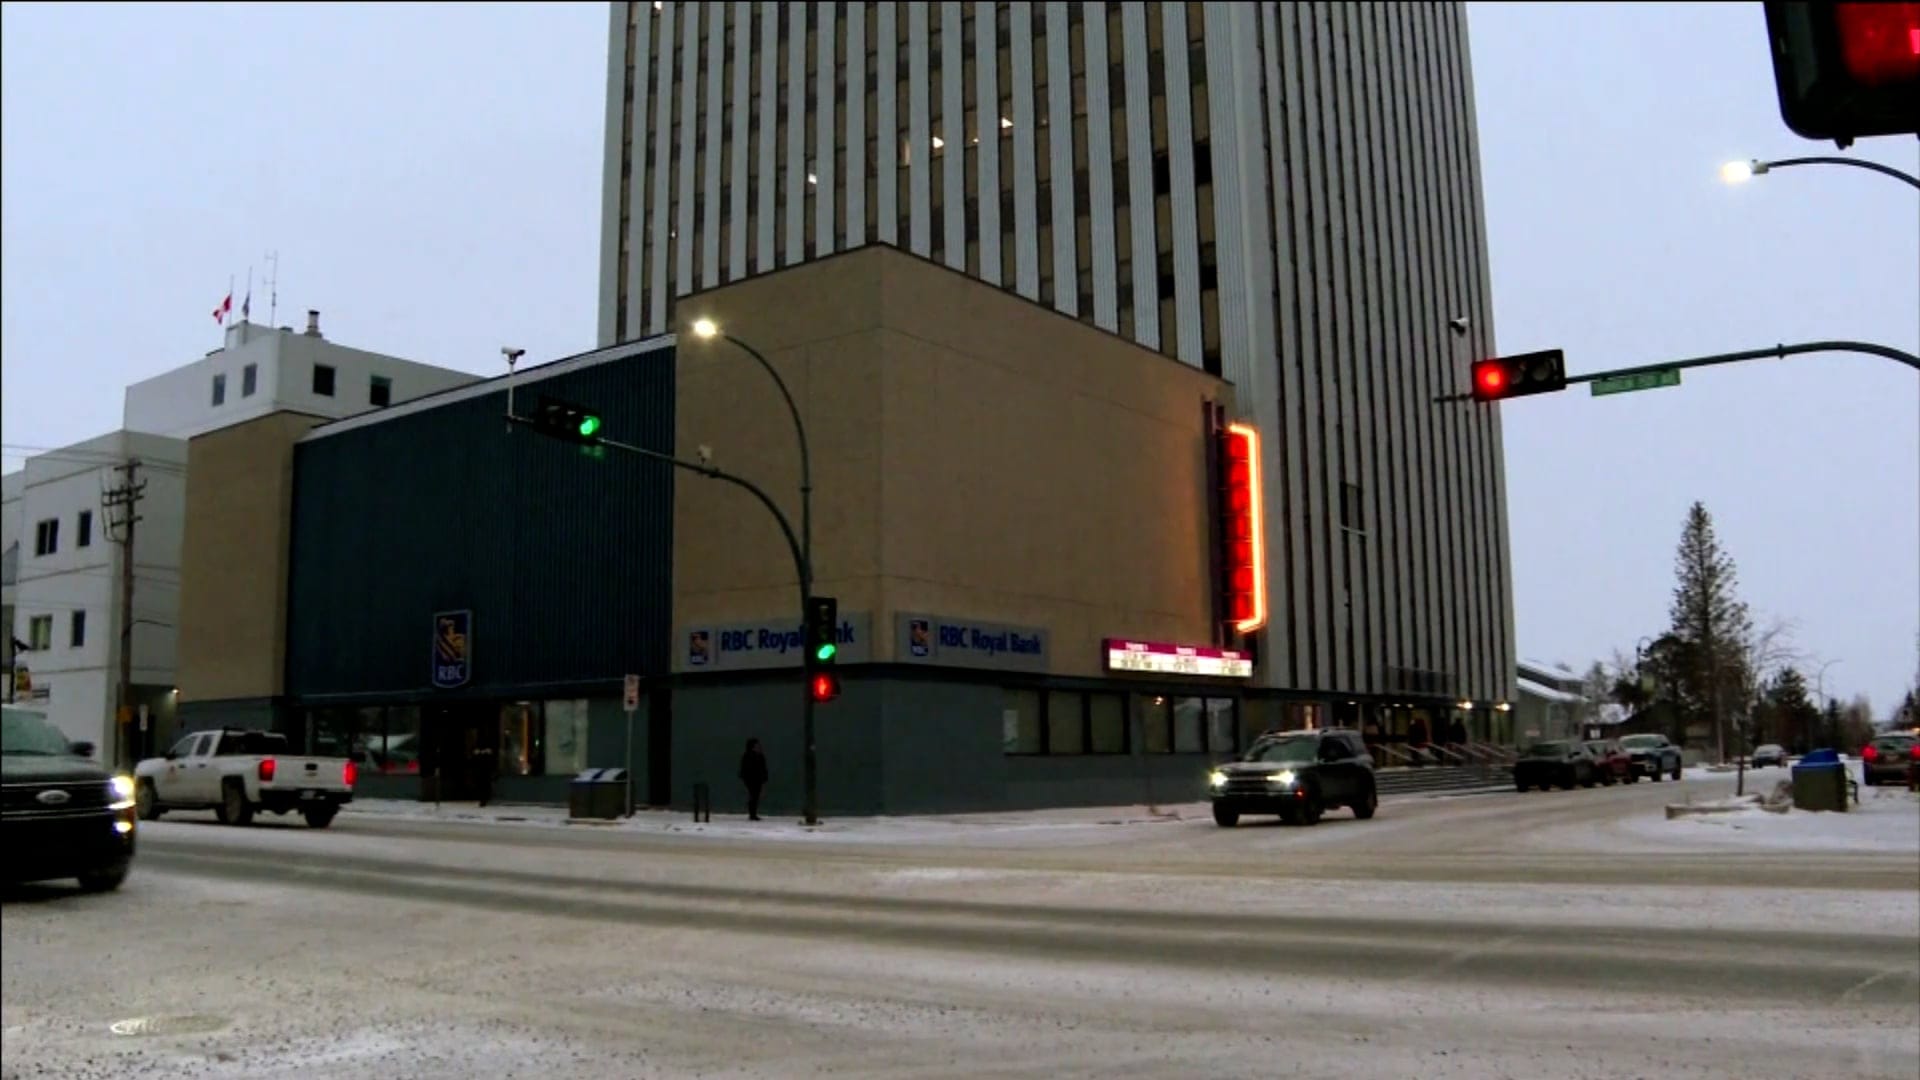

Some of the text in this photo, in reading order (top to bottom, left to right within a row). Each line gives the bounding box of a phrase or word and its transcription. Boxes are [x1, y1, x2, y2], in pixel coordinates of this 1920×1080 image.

[721, 630, 753, 651] RBC
[758, 626, 806, 653] Royal
[940, 626, 1041, 655] RBC Royal Bank
[438, 664, 465, 681] RBC
